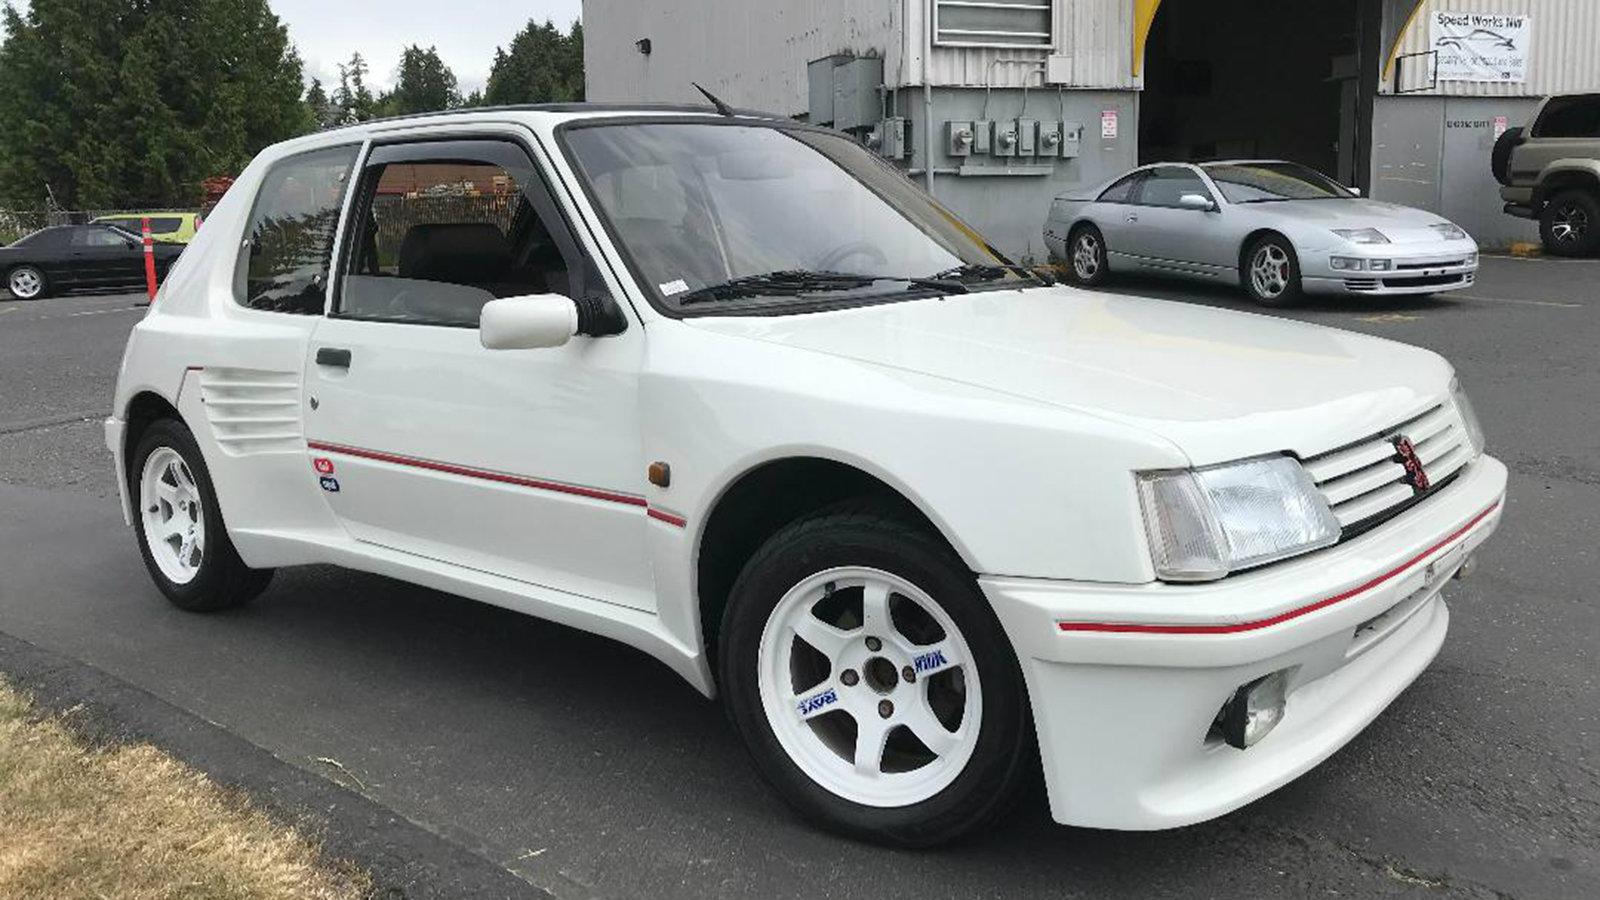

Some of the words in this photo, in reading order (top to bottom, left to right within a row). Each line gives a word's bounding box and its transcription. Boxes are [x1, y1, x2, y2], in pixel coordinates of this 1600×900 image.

[1438, 13, 1469, 27] Speed
[1472, 16, 1503, 28] Works
[801, 692, 838, 715] RAYS
